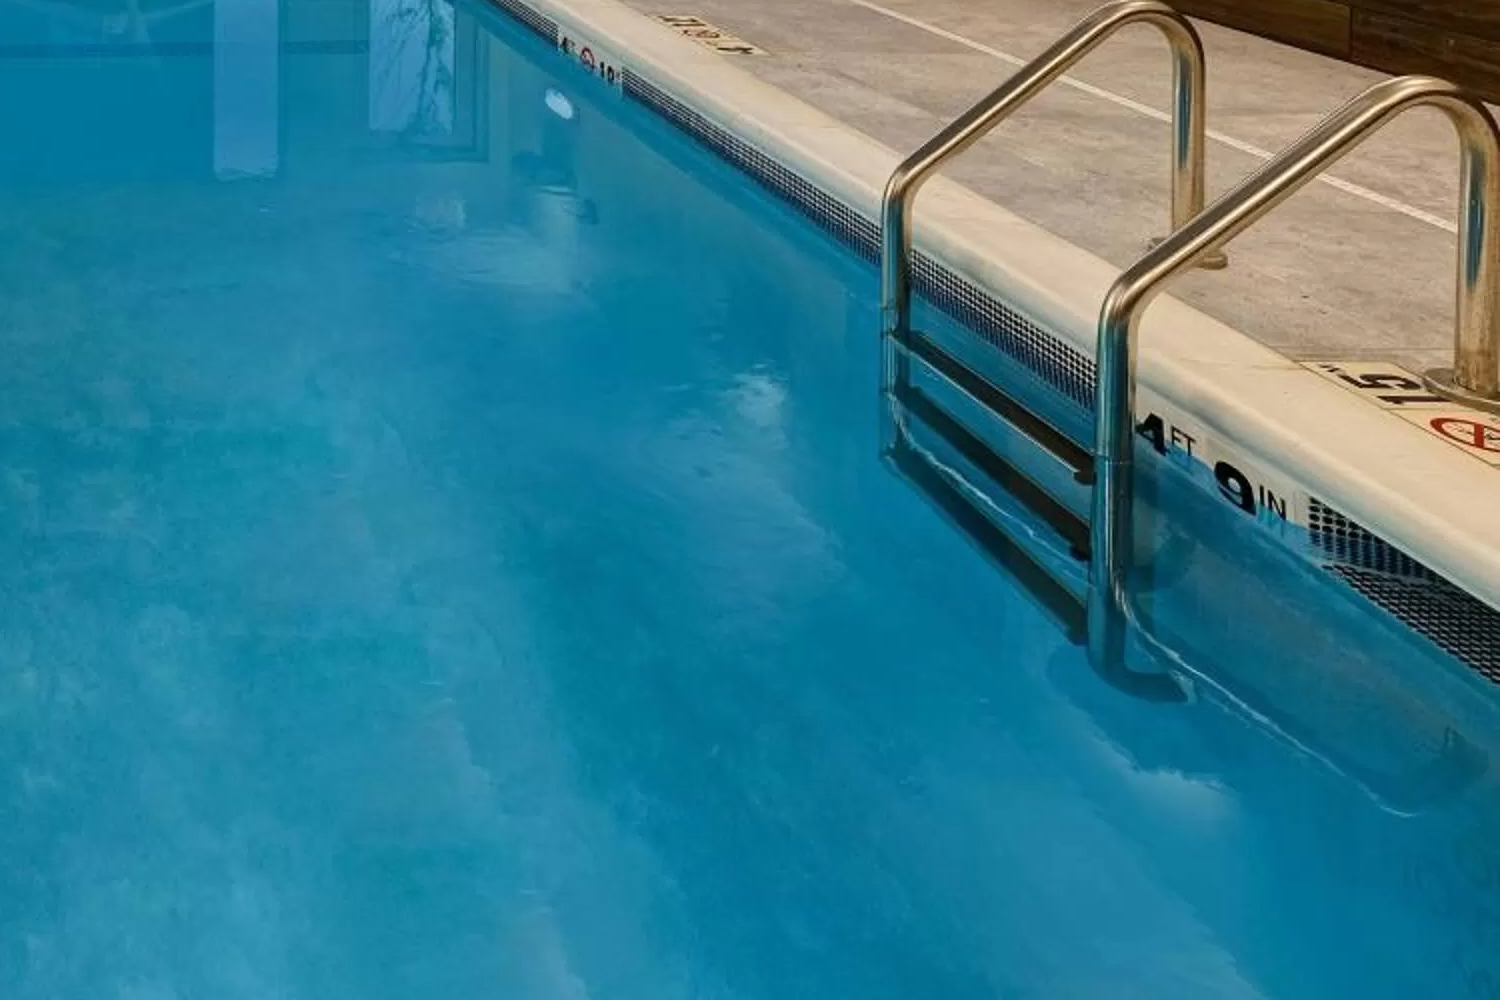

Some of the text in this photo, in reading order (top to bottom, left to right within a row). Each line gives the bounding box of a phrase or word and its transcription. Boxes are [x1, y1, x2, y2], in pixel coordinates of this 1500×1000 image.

[1134, 412, 1287, 521] 4 FT 9 IN
